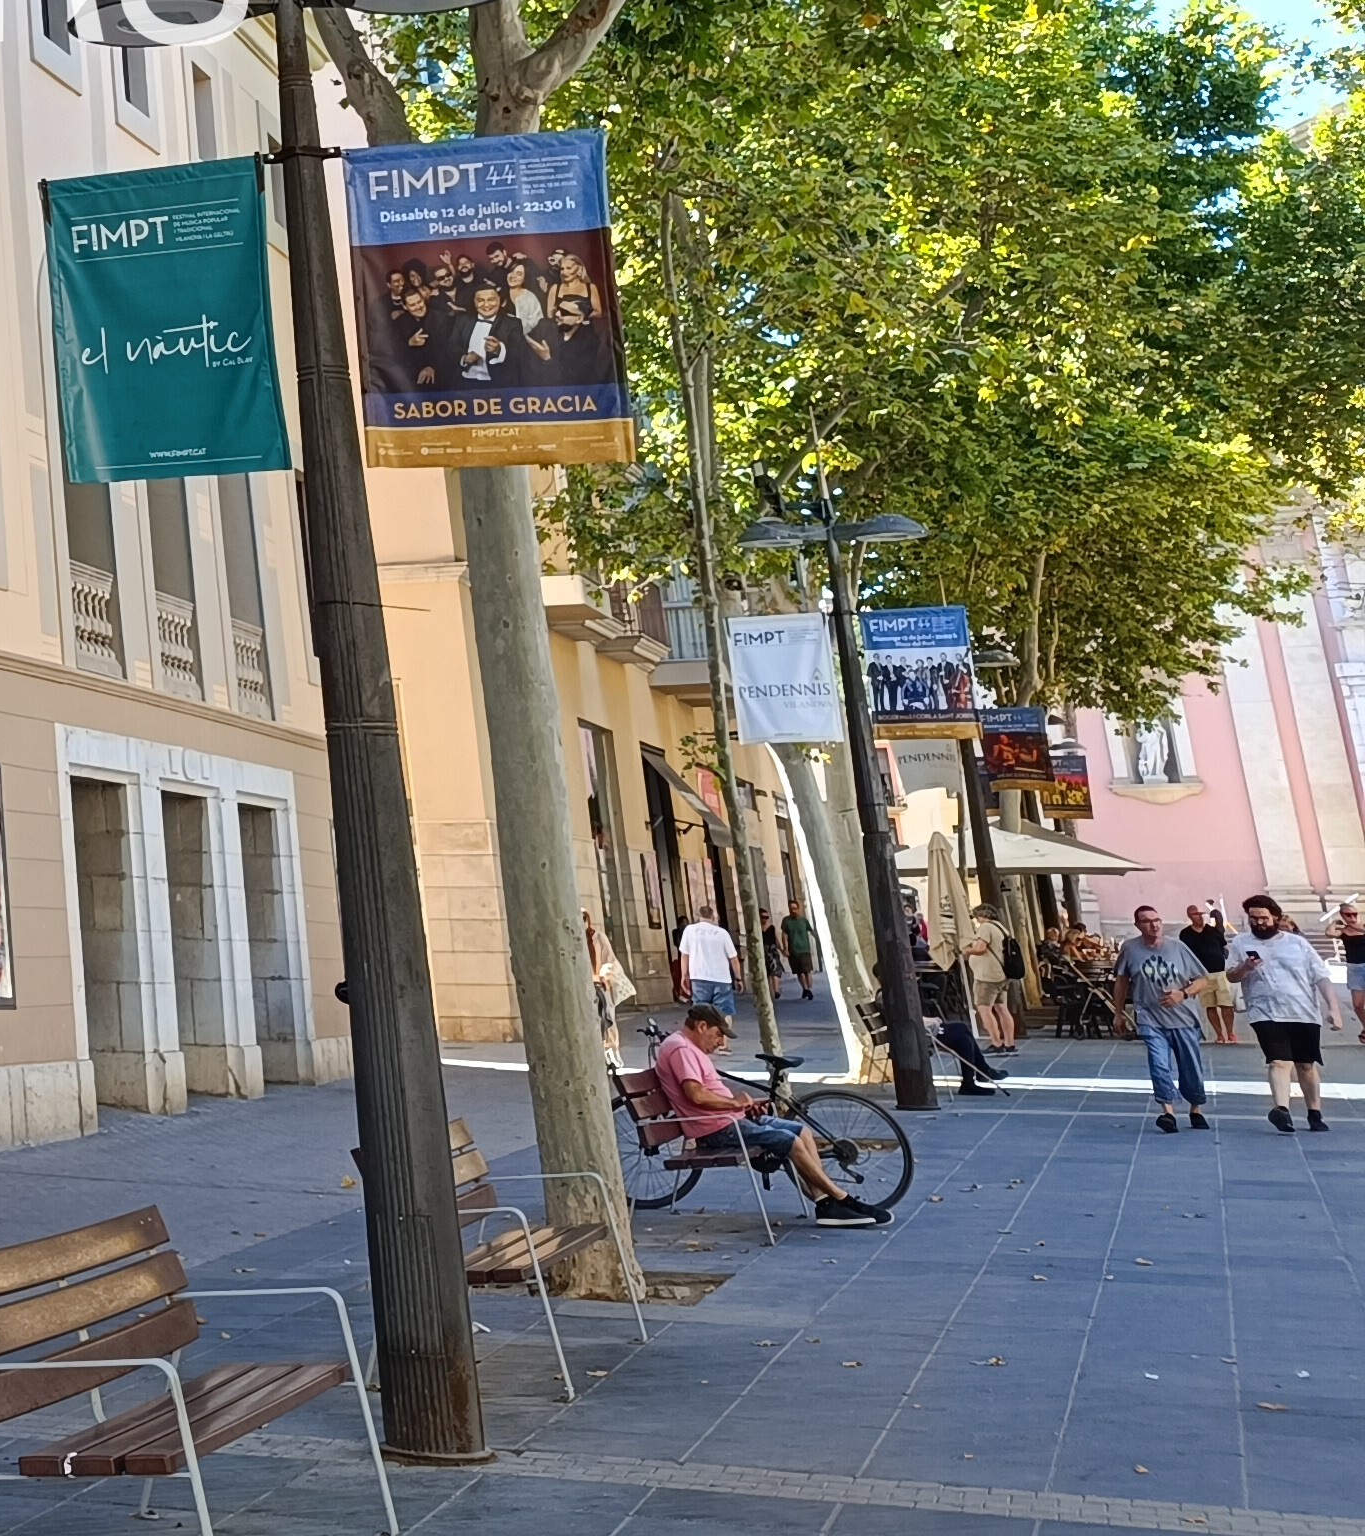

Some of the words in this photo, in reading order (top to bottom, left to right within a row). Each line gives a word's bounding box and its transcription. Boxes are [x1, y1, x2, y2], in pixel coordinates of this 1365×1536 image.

[369, 162, 483, 201] FIMPT
[485, 165, 517, 185] 44
[380, 207, 438, 223] Dissabte
[440, 208, 455, 219] 12
[457, 204, 475, 216] de
[477, 200, 513, 220] juliol
[523, 198, 563, 213] 22:30
[566, 196, 576, 209] h
[70, 215, 169, 253] FIMPT
[429, 219, 466, 236] Plaça
[469, 219, 491, 232] del
[494, 216, 526, 230] Port
[81, 327, 109, 375] el
[394, 401, 467, 420] SABOR
[473, 397, 503, 416] DE
[509, 395, 598, 415] GRACIA
[471, 428, 520, 439] FIMPT.CAT
[869, 617, 918, 633] FIMPT
[733, 630, 785, 647] FIMPT
[739, 682, 831, 700] PENDENNIS
